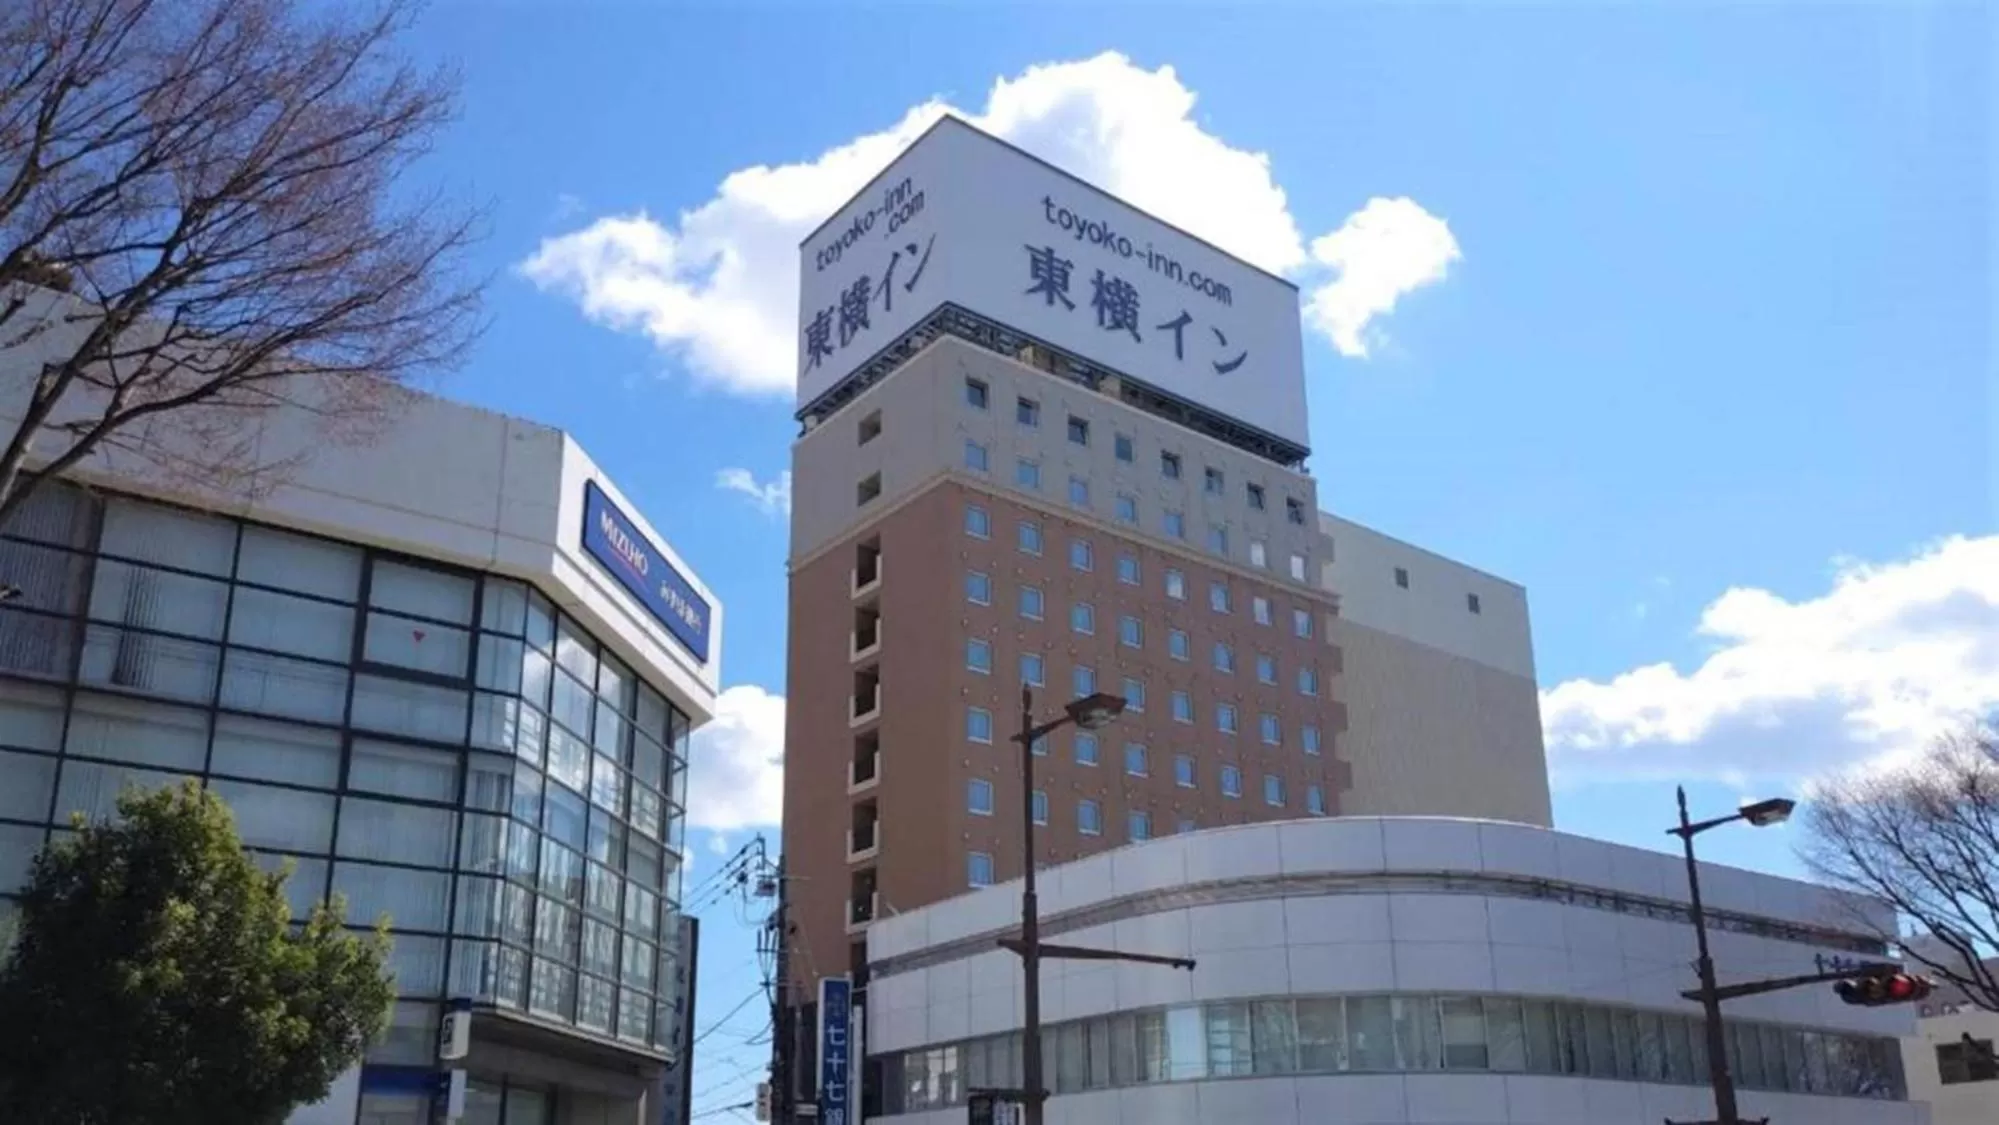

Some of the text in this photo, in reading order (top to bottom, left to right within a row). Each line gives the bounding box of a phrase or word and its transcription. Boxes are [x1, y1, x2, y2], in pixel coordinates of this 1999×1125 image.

[816, 177, 912, 272] toyoko-inn
[884, 191, 925, 240] .com
[1042, 195, 1232, 307] toyoko-inn.com
[803, 232, 937, 377] 東横イン
[1023, 243, 1248, 375] 東横イン
[601, 509, 648, 576] MIZUHO
